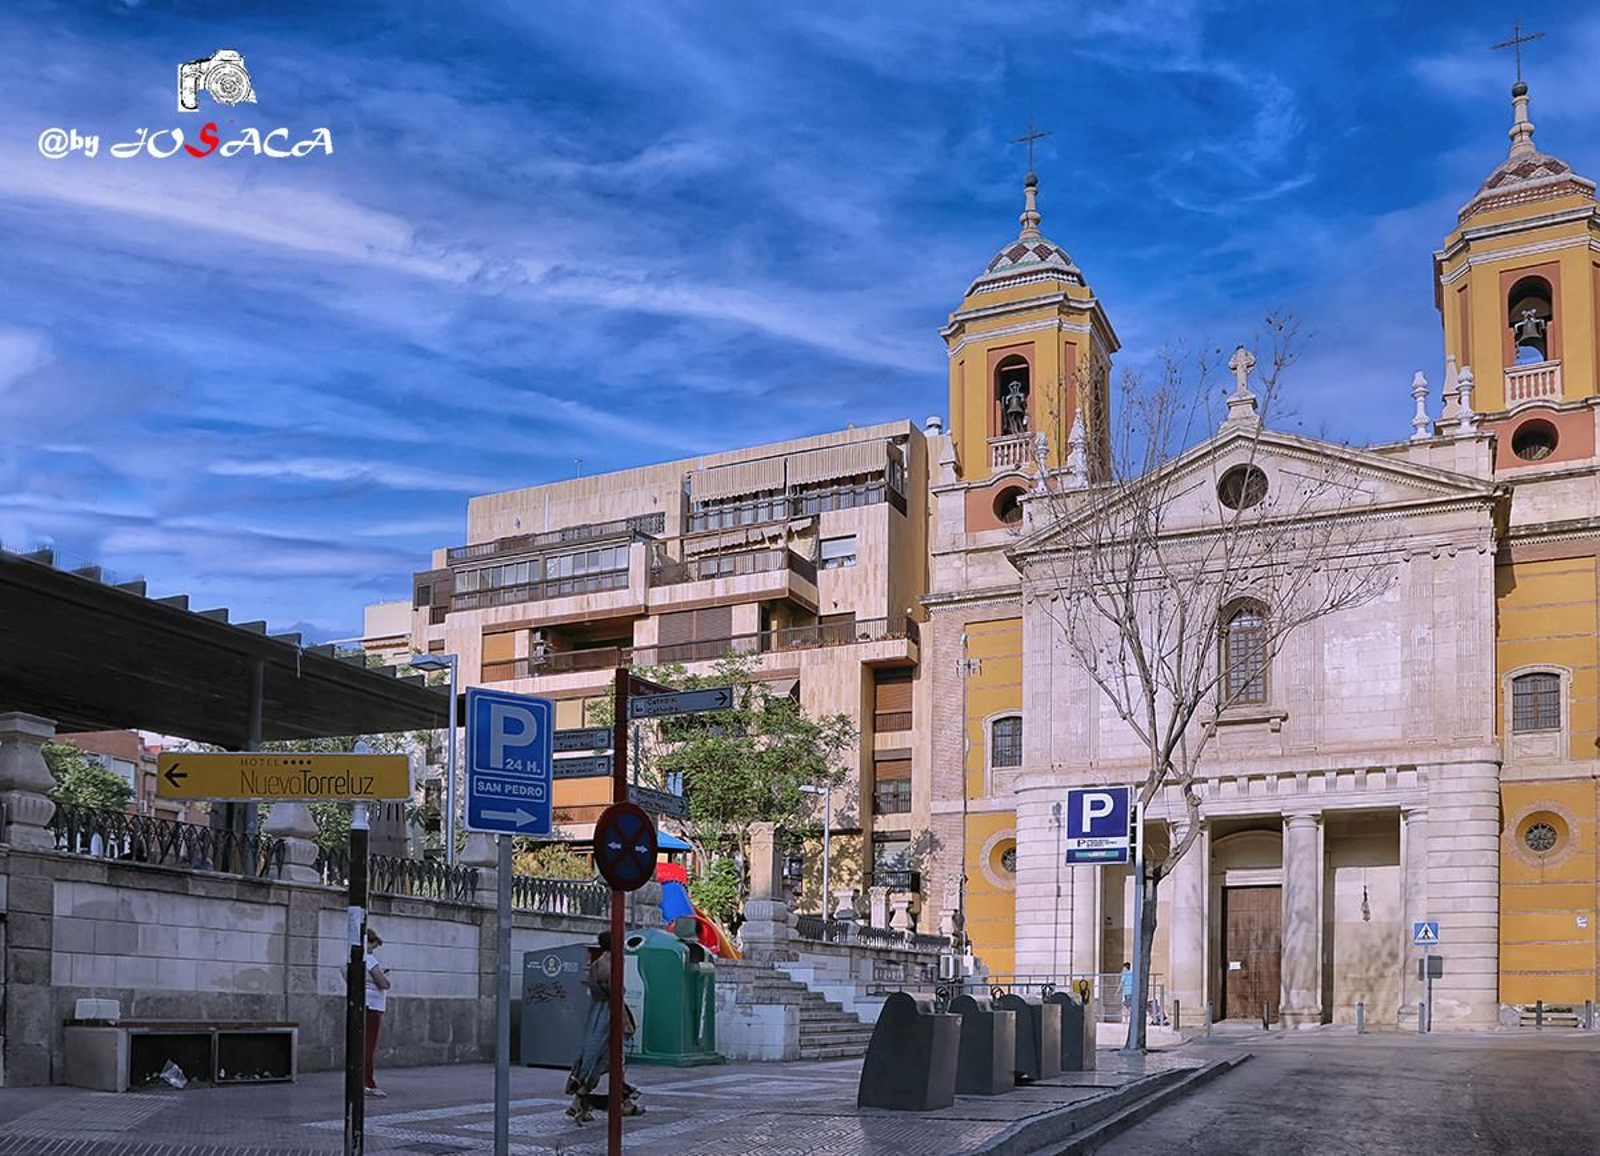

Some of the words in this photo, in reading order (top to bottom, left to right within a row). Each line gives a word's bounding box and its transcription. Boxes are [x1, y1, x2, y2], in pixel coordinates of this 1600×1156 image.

[490, 703, 538, 769] P
[240, 757, 279, 767] HOTEL
[505, 758, 522, 771] 24
[527, 761, 541, 773] H.
[477, 781, 501, 793] SAN
[504, 784, 543, 797] PEDRO
[1082, 793, 1114, 833] P
